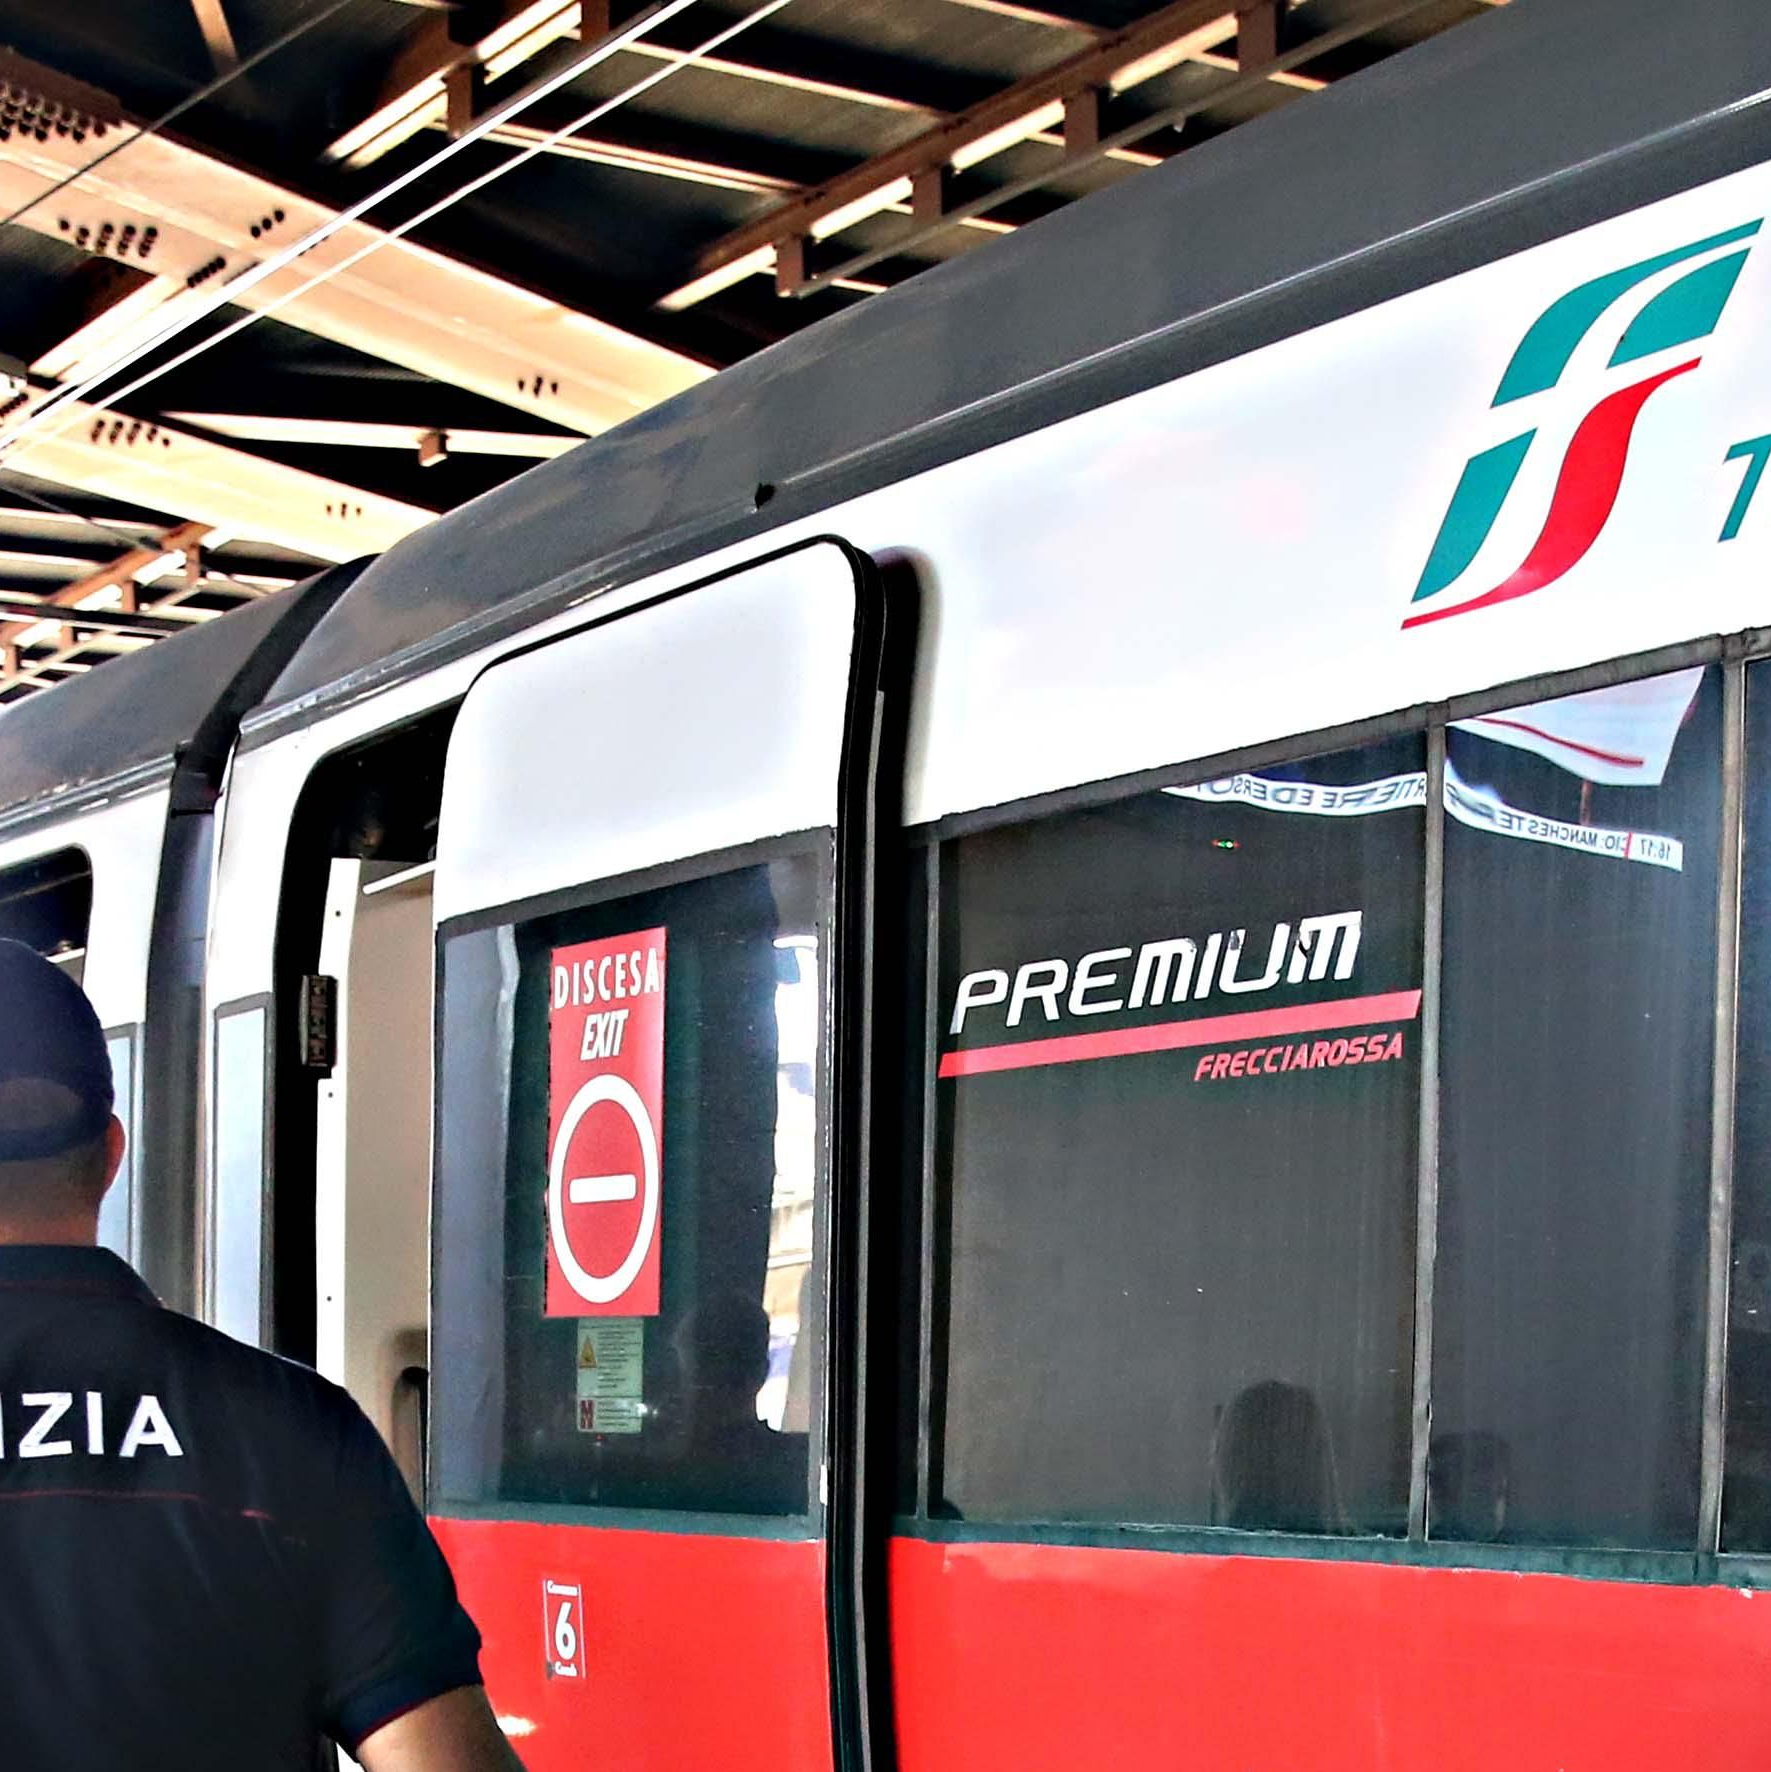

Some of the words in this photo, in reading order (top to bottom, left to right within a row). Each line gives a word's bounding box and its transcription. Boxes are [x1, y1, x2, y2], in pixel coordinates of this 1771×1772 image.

[554, 947, 660, 1009] DISCESA
[949, 910, 1363, 1035] PREMIUM
[580, 1008, 630, 1061] EXIT
[1194, 1032, 1404, 1081] FRECCIAROSSA
[554, 1601, 577, 1660] 6
